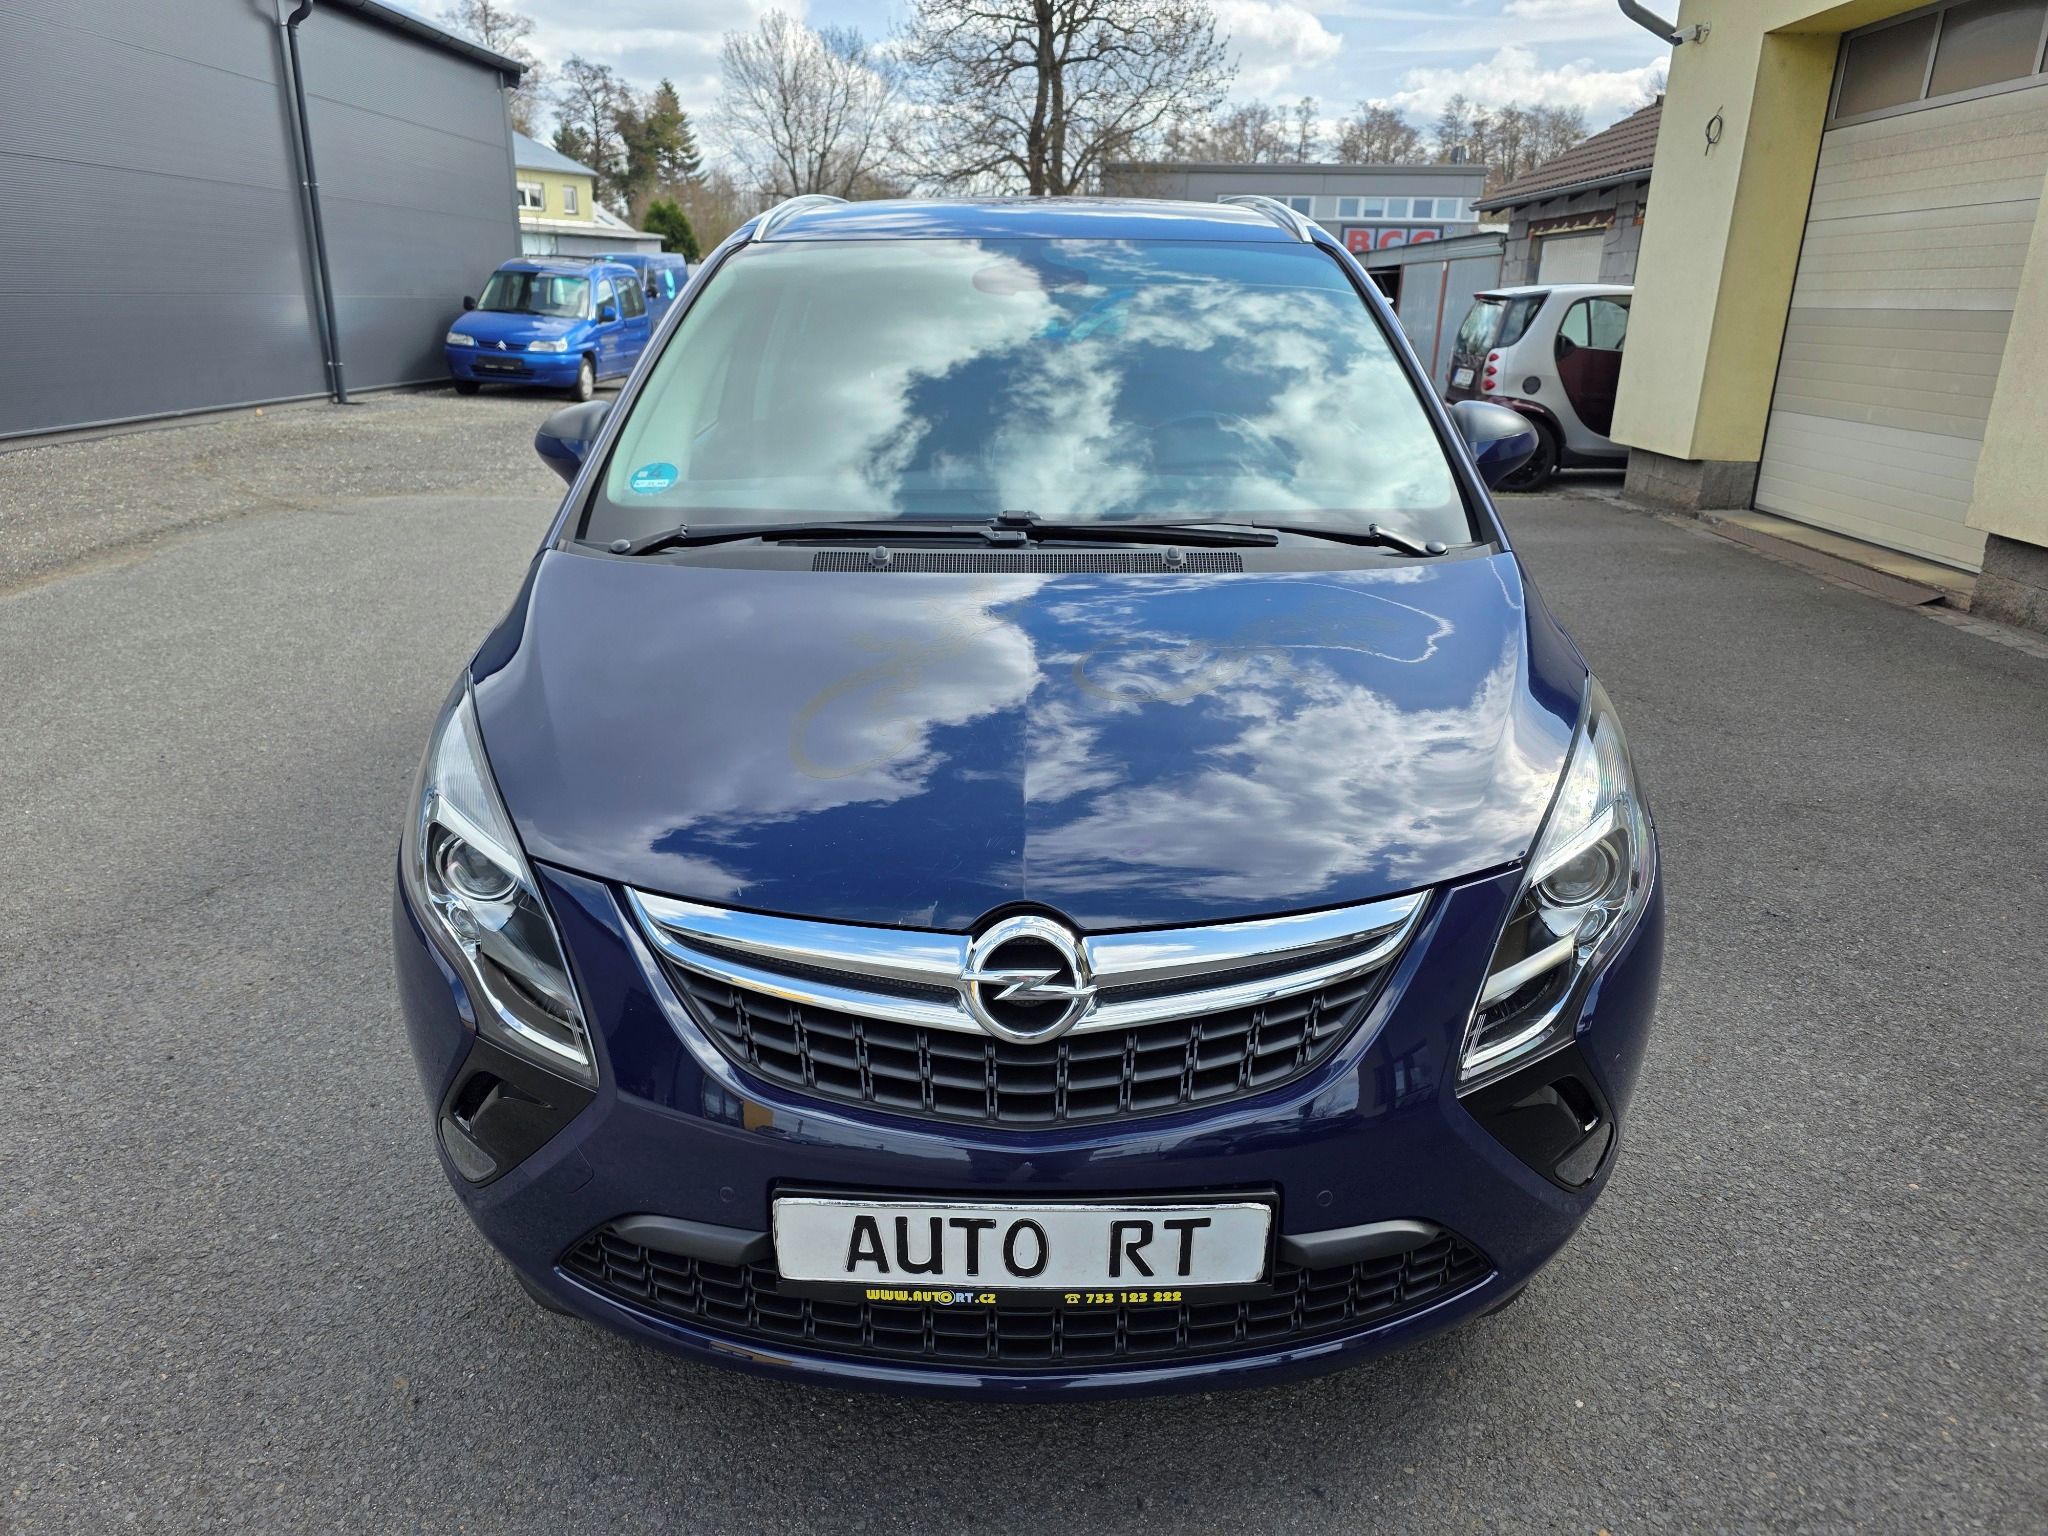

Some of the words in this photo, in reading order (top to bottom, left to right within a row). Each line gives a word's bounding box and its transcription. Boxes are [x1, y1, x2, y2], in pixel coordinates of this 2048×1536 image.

[845, 1215, 1050, 1278] AUTO
[1108, 1217, 1212, 1277] RT
[1085, 1293, 1114, 1304] 733
[1120, 1292, 1148, 1303] 123
[1153, 1291, 1182, 1303] 222
